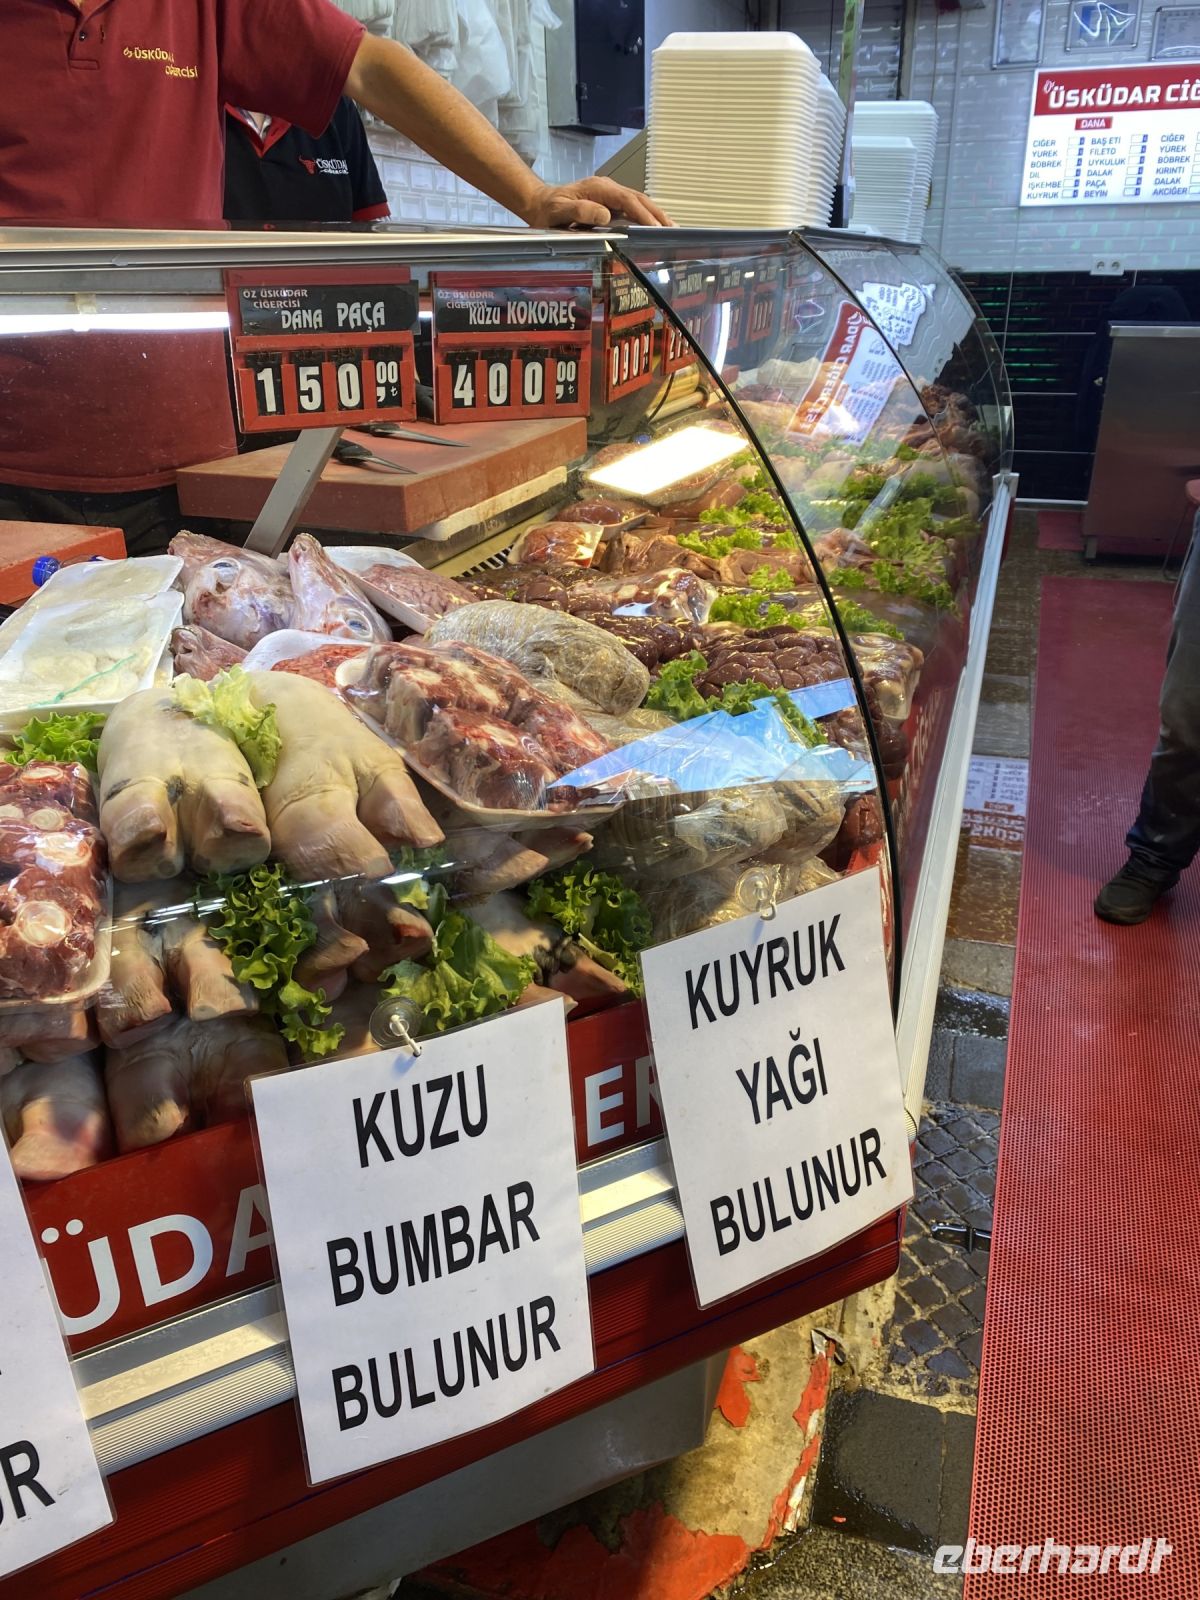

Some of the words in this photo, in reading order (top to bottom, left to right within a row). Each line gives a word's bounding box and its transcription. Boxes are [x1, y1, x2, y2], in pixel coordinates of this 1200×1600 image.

[1048, 84, 1162, 109] ÜSKÜDAR
[1081, 119, 1106, 129] DANA
[1091, 137, 1107, 146] BAŞ
[1086, 169, 1113, 177] DALAK
[1088, 158, 1126, 166] UYKULUK
[1085, 180, 1106, 188] PAÇA
[1154, 177, 1181, 185] DALAK
[1027, 191, 1059, 199] KUYRUK
[243, 289, 257, 298] ÖZ
[260, 288, 308, 298] ÜSKÜDAR
[281, 309, 323, 330] DANA
[336, 301, 386, 333] PAÇA
[469, 306, 501, 325] KUZU
[507, 301, 577, 329] KOKOREÇ
[686, 914, 845, 1029] KUYRUK
[736, 1028, 828, 1124] YAĞI
[352, 1065, 489, 1168] KUZU
[710, 1127, 887, 1256] BULUNUR
[326, 1180, 540, 1306] BUMBAR
[331, 1295, 561, 1431] BULUNUR
